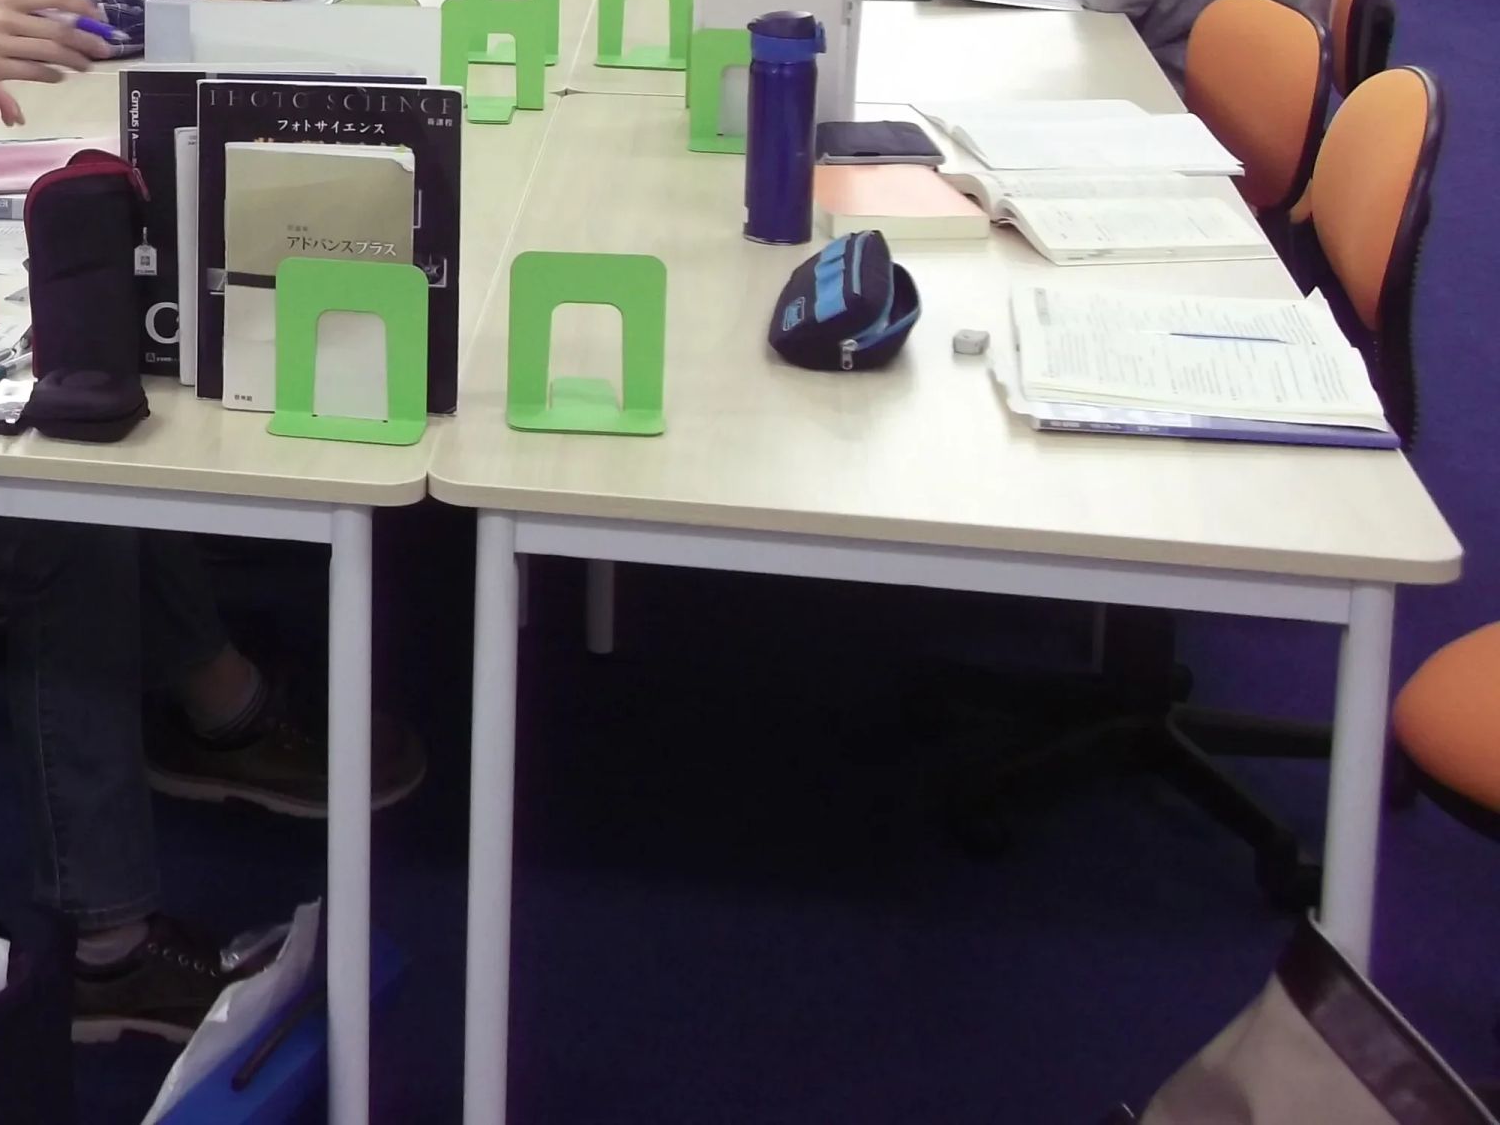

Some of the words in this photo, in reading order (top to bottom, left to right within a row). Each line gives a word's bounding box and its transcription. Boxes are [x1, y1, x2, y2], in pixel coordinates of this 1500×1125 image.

[129, 89, 141, 127] Campus
[209, 89, 310, 110] PHOTO
[326, 90, 454, 115] SCIENCE
[277, 119, 386, 135] フォトサイエンス
[286, 236, 397, 256] アドバンスプラス
